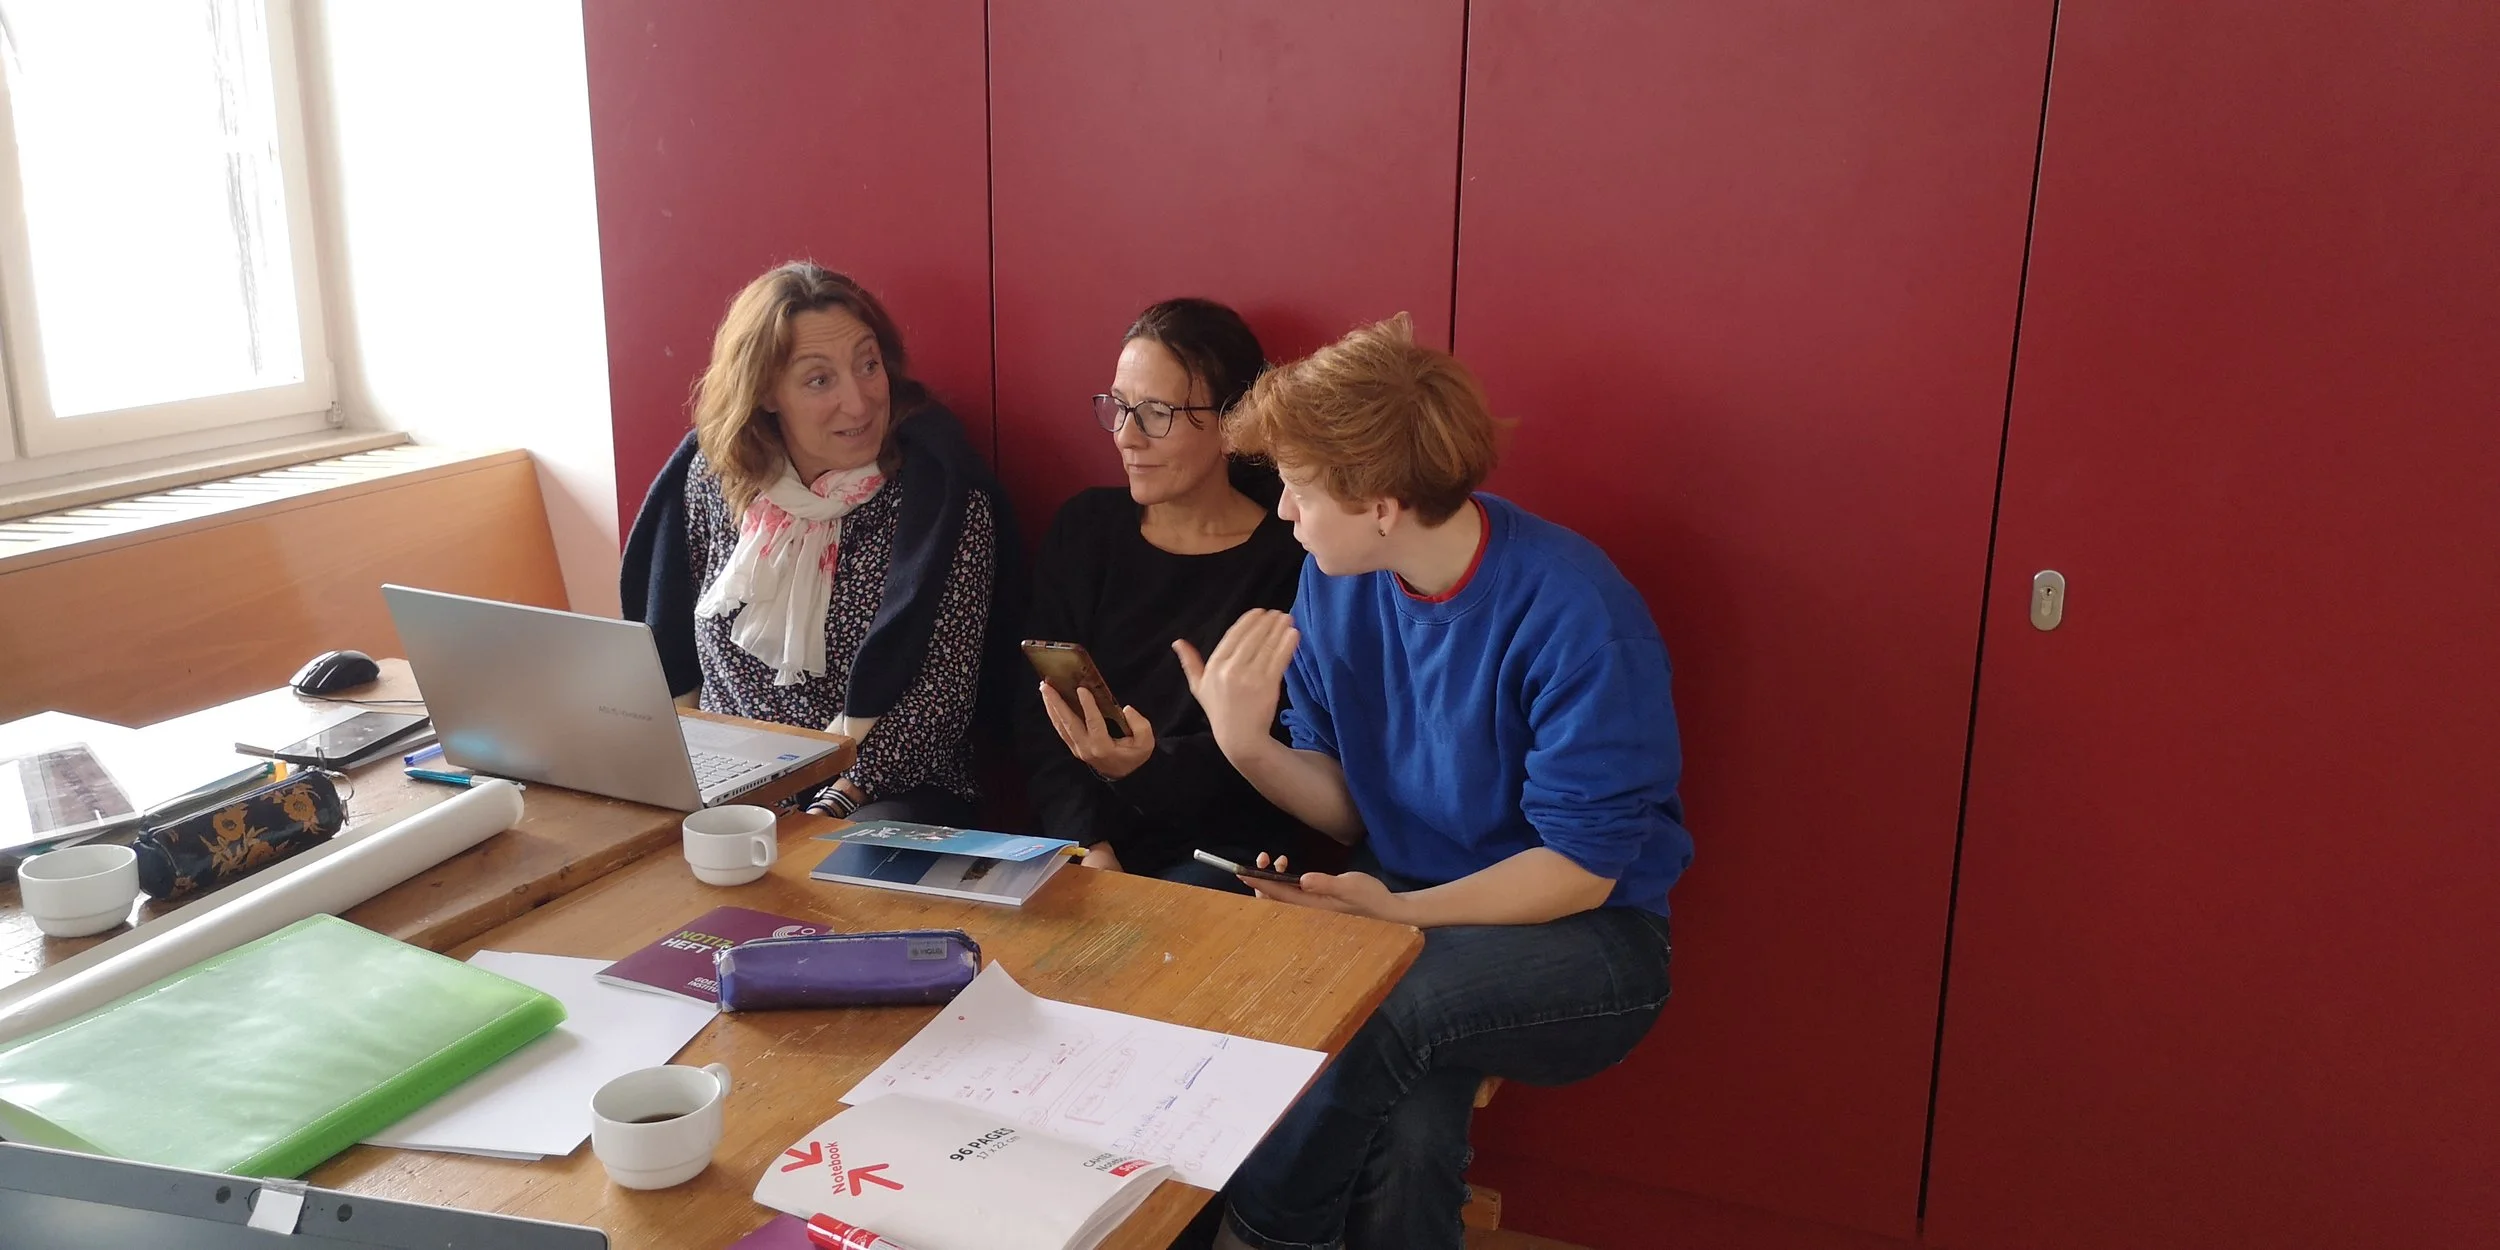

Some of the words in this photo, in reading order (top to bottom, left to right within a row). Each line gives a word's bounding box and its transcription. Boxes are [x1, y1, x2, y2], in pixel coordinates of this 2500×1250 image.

[660, 938, 712, 954] HEFT
[687, 981, 719, 993] INSTITU
[694, 977, 719, 986] GOET
[949, 1147, 973, 1162] 96
[967, 1127, 1015, 1149] PAGES
[976, 1151, 989, 1160] 17
[992, 1141, 1008, 1150] 22
[1006, 1135, 1021, 1143] cm
[824, 1141, 846, 1195] Notebook
